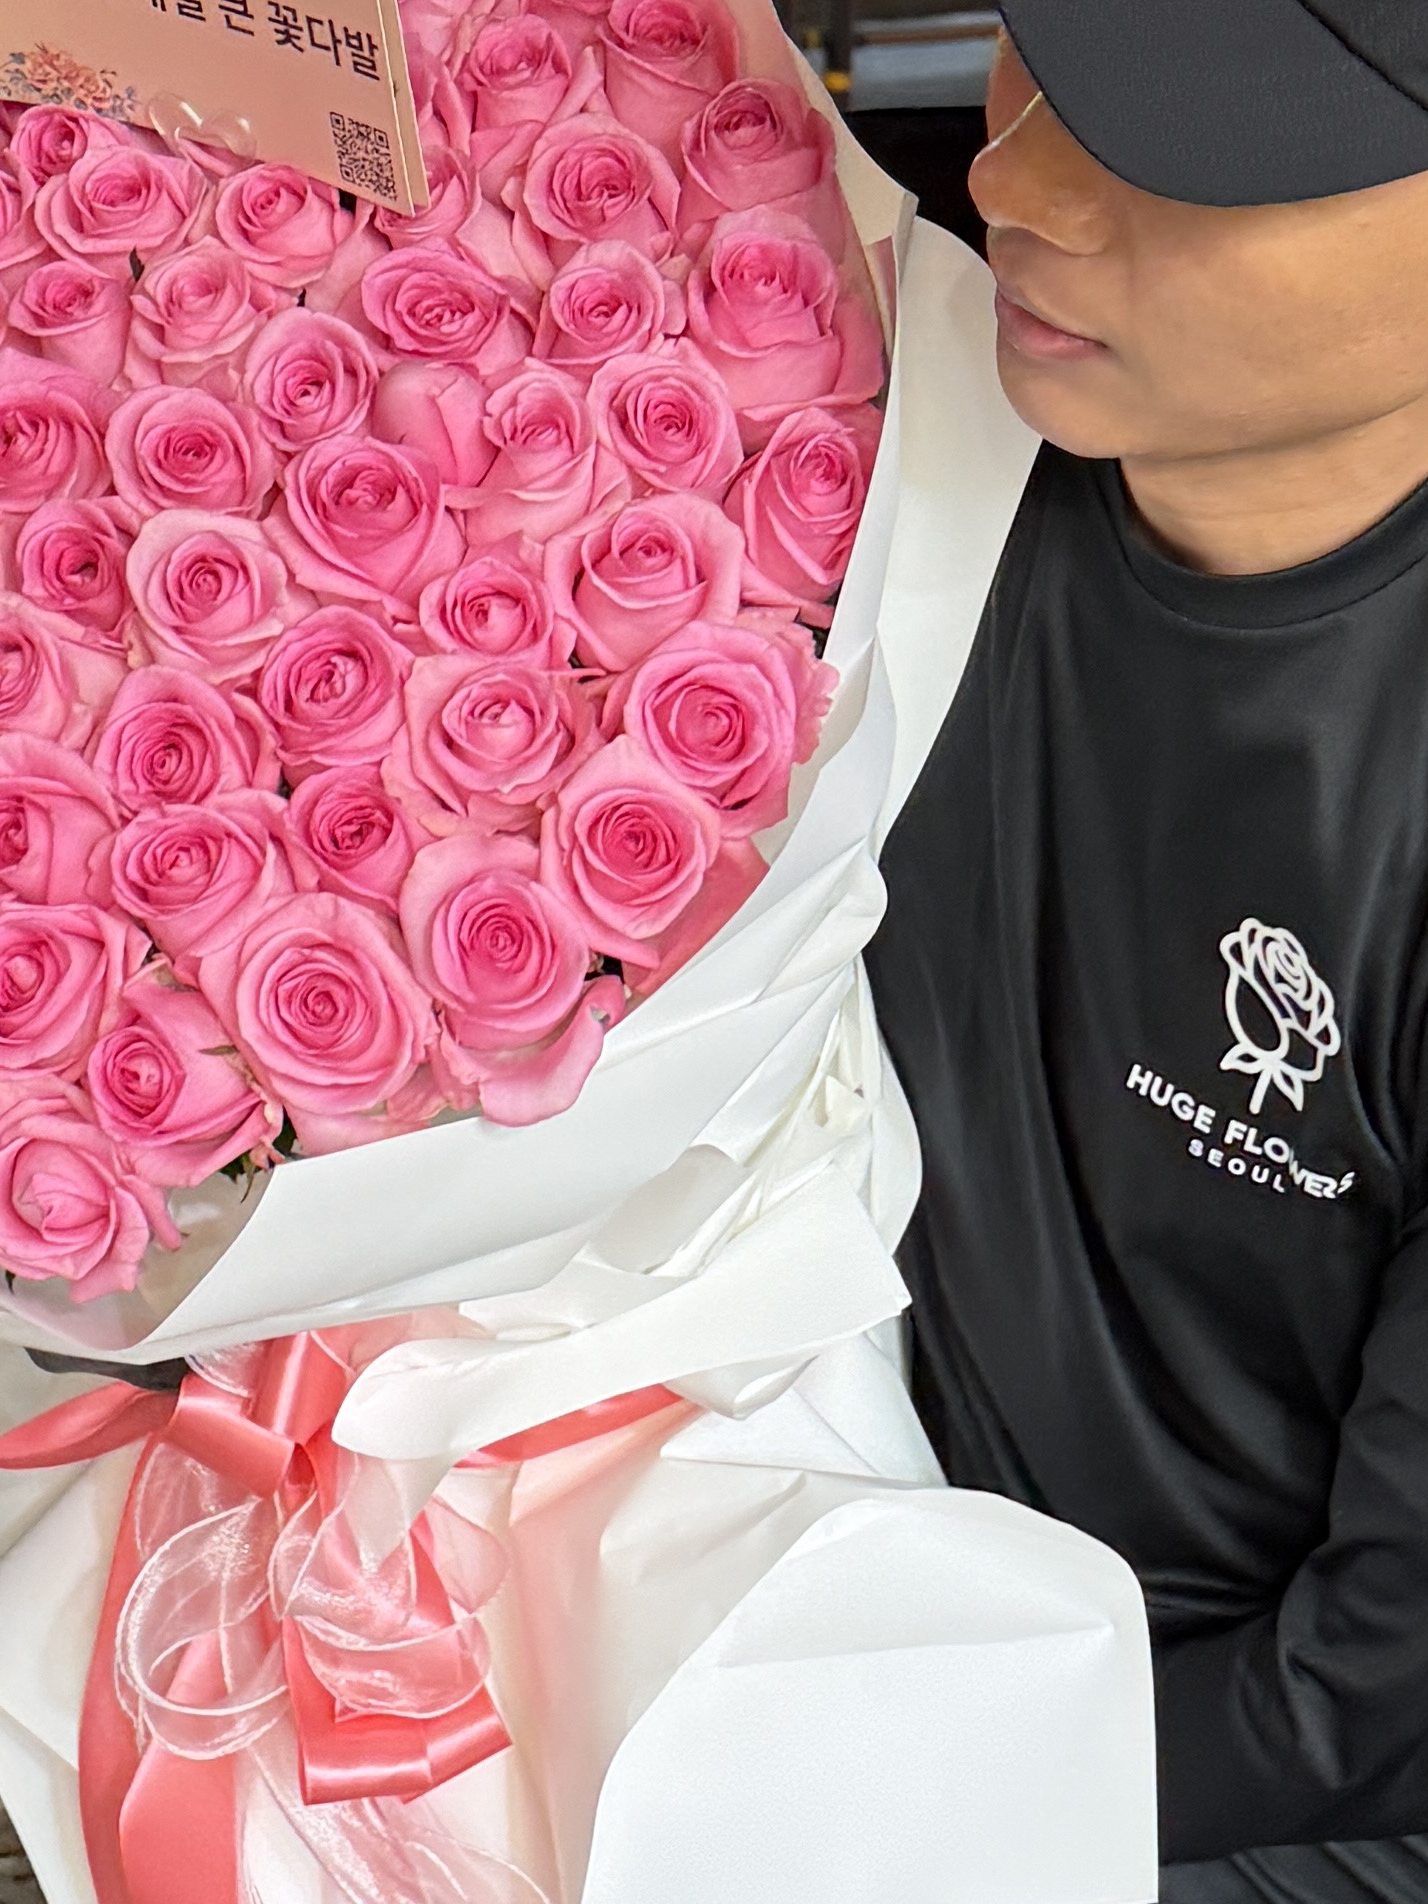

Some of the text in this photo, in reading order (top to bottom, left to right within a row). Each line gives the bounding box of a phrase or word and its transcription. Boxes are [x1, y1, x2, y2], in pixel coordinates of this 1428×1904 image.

[1126, 1063, 1356, 1199] HUGE FLOWERS
[1188, 1138, 1286, 1193] SEOUL
